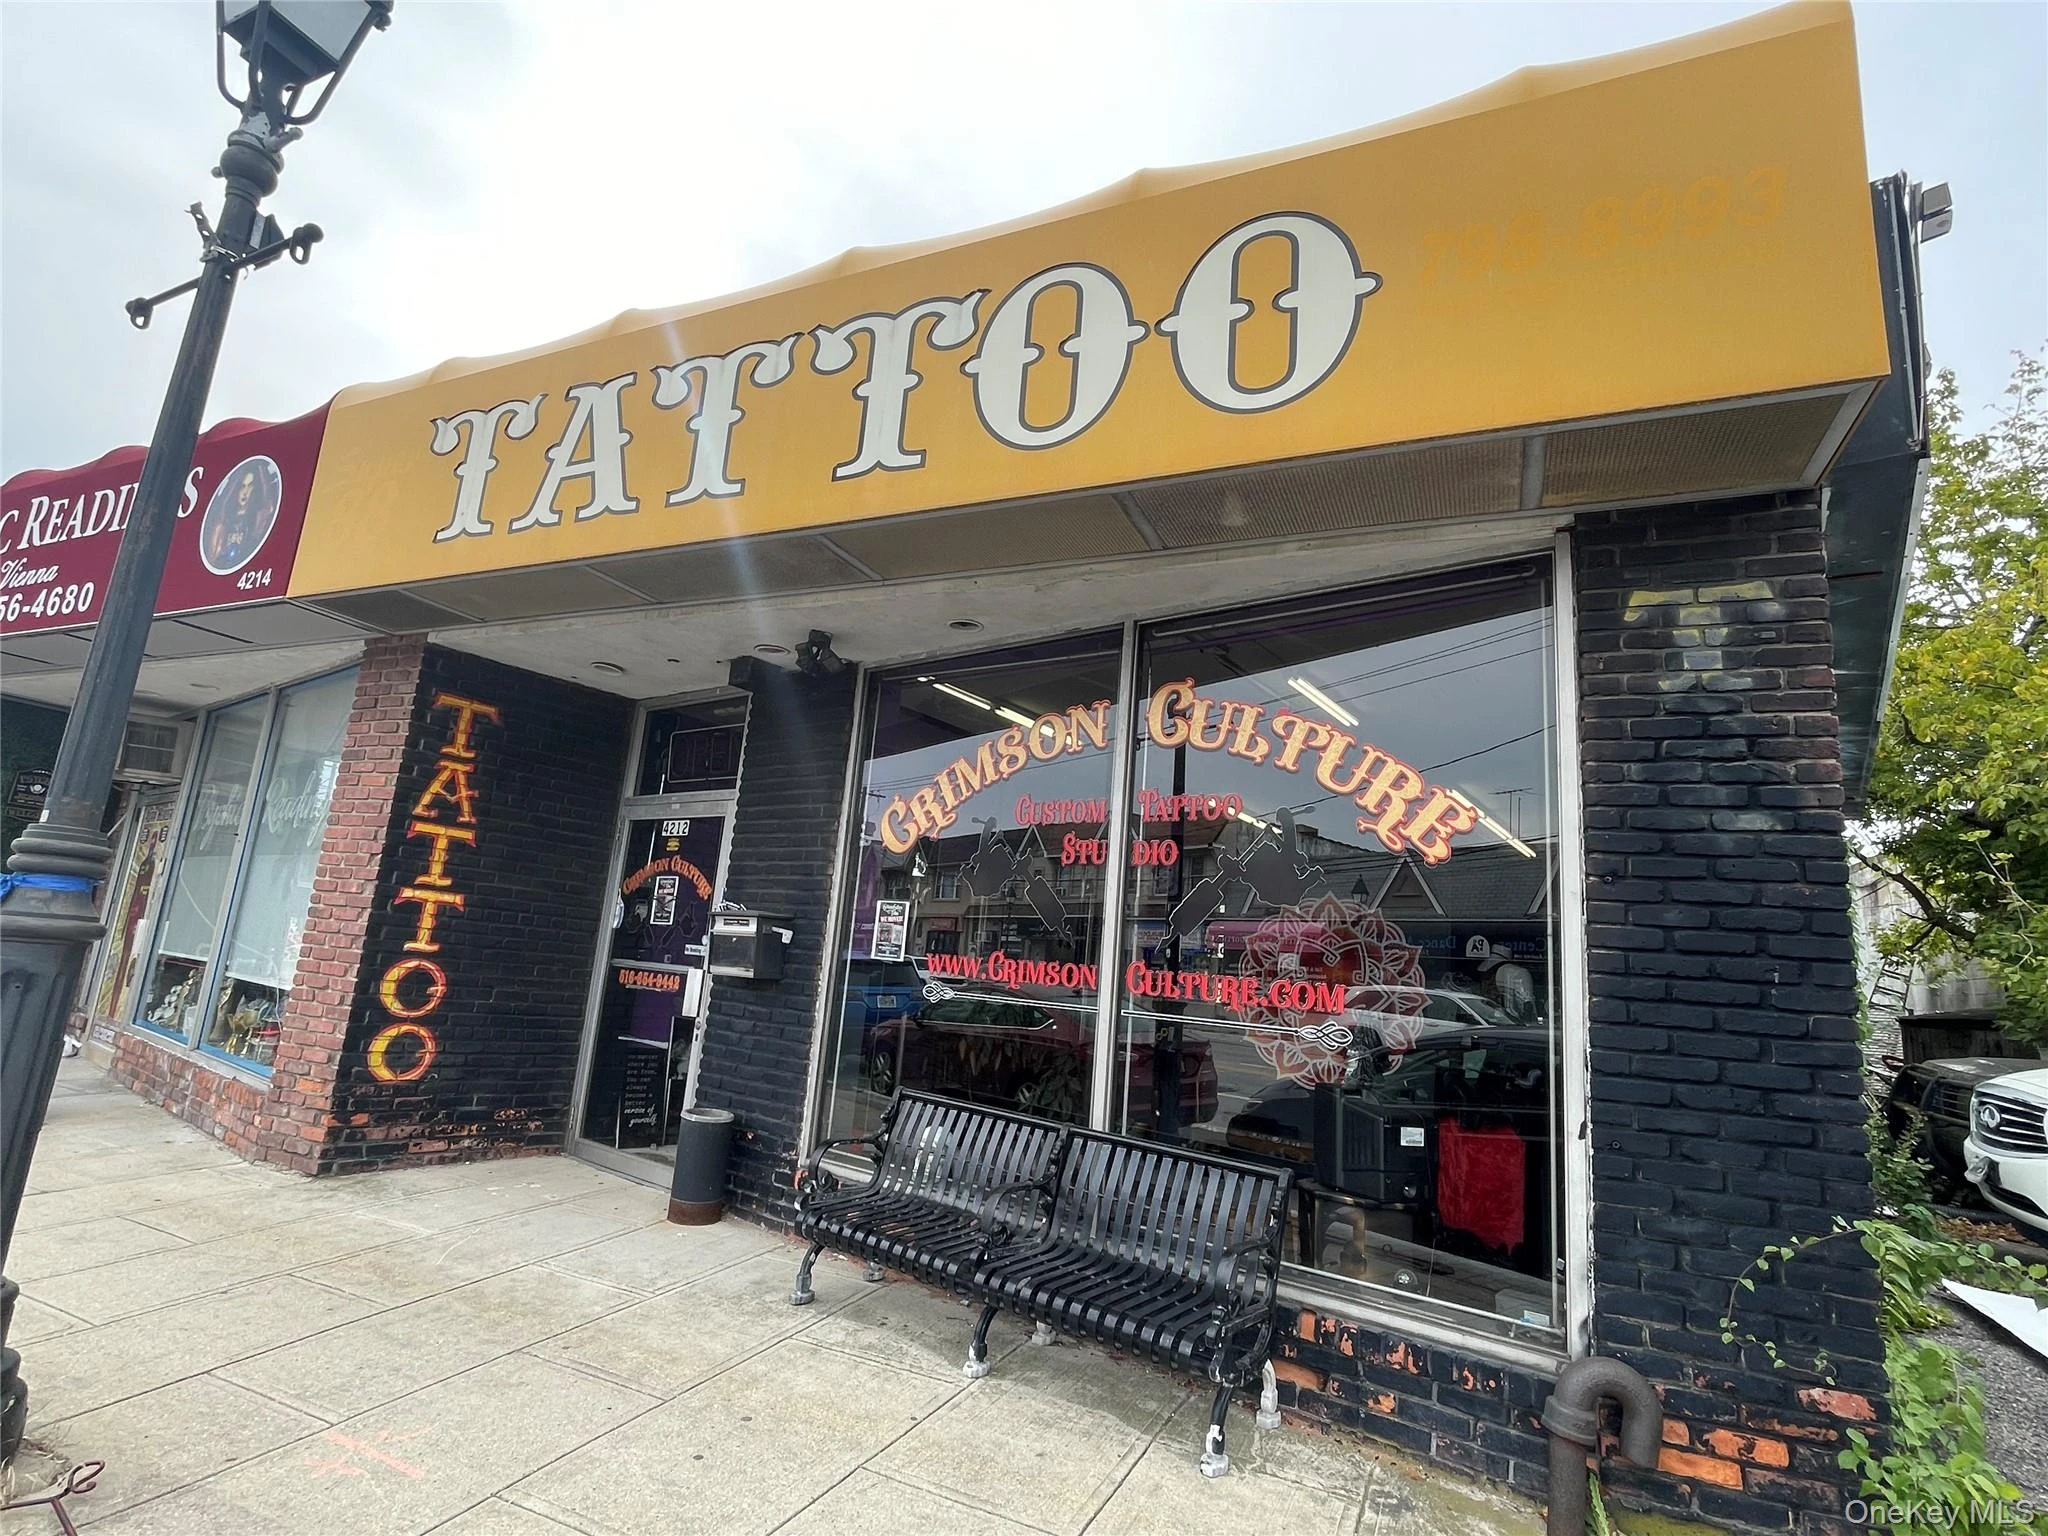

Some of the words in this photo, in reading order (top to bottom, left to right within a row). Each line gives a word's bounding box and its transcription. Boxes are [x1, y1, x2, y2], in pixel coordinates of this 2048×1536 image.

[430, 211, 1383, 543] TATTOO
[17, 466, 204, 550] READIS
[237, 567, 273, 591] 4214
[880, 698, 1111, 855] CRIMSON
[1144, 676, 1479, 869] CULTURE
[1014, 793, 1110, 828] CUSTOM
[1136, 786, 1243, 823] TATTOO
[662, 820, 689, 835] 4212
[366, 691, 500, 1083] TATTOO
